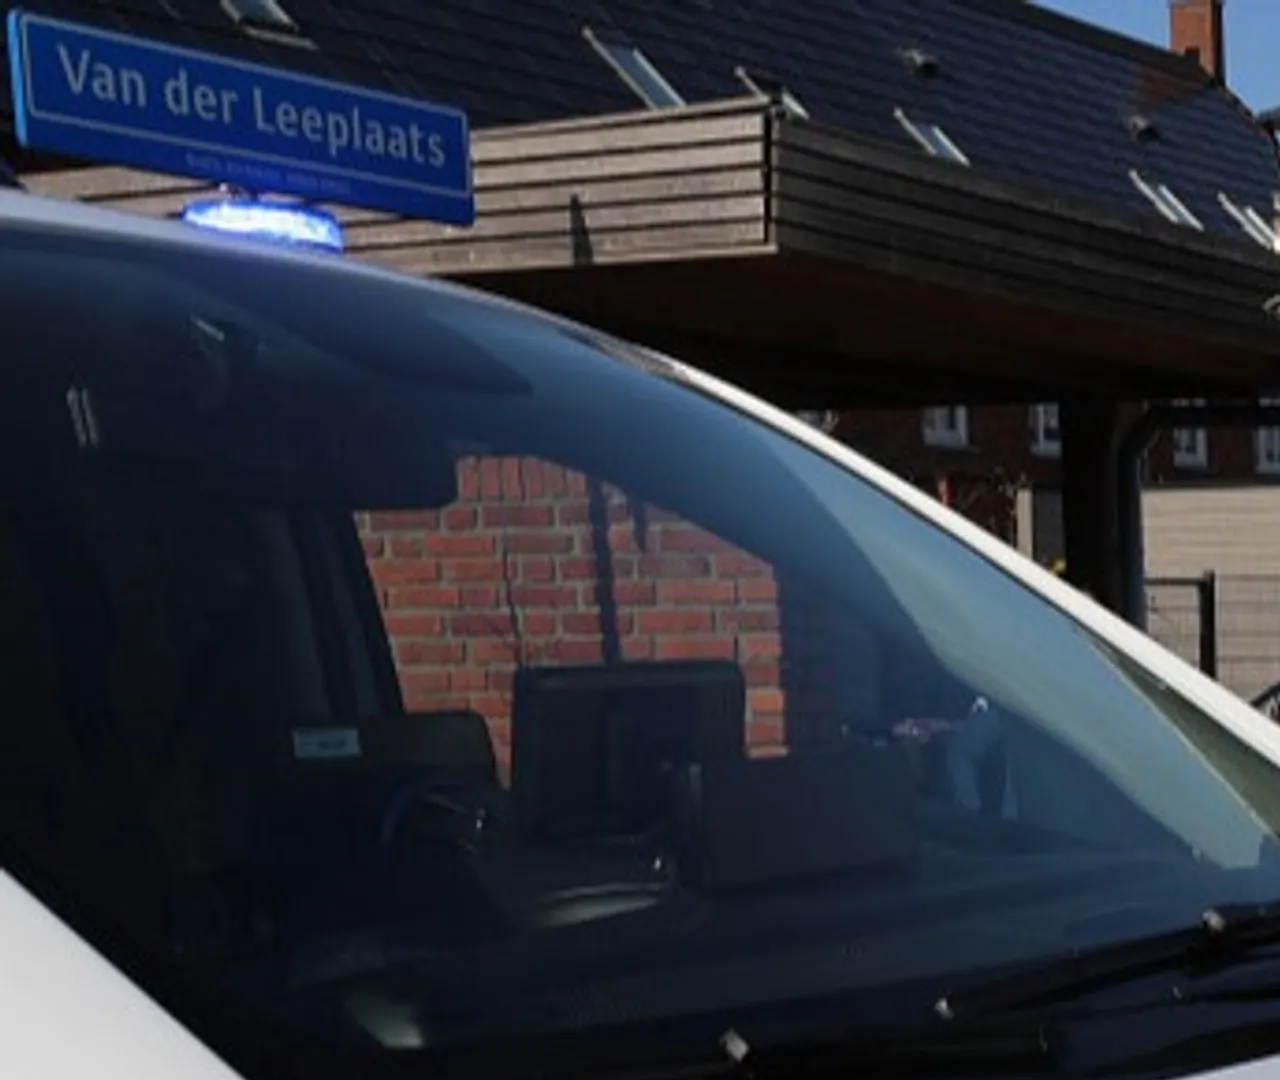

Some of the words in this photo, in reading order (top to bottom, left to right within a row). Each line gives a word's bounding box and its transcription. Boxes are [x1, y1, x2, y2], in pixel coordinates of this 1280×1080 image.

[57, 44, 147, 108] Van
[164, 68, 238, 125] der
[253, 87, 446, 168] Leeplaats
